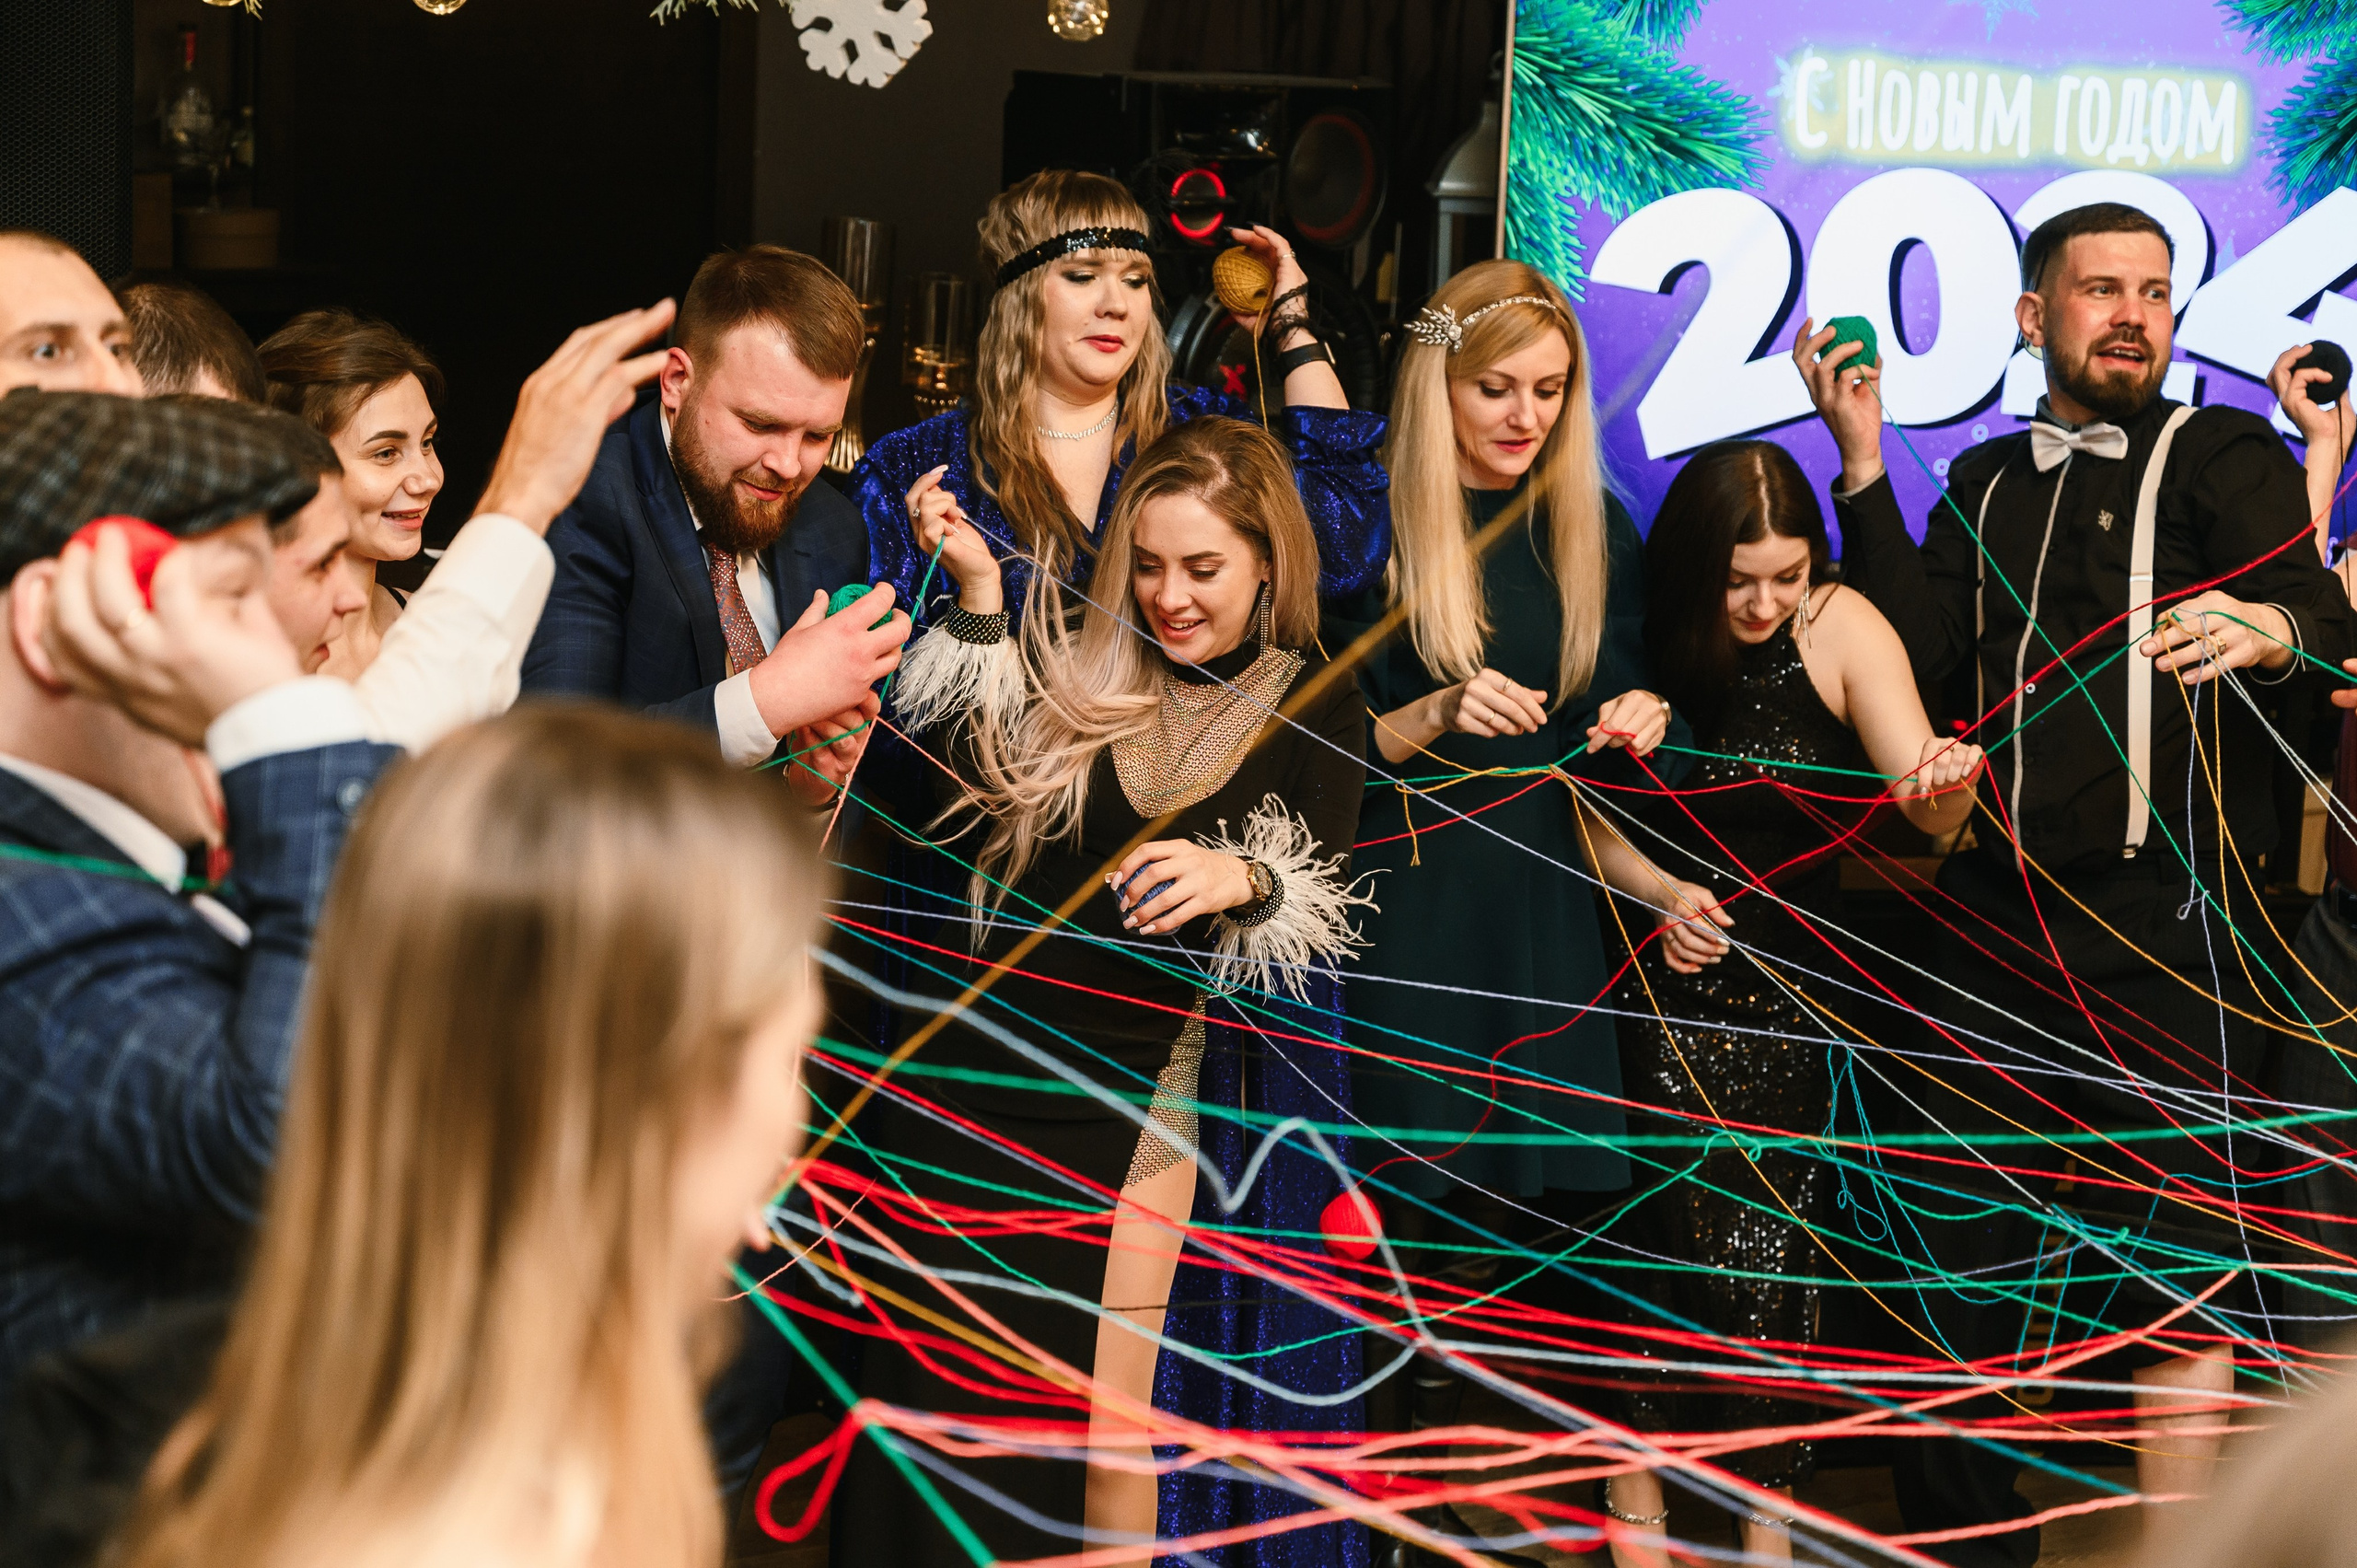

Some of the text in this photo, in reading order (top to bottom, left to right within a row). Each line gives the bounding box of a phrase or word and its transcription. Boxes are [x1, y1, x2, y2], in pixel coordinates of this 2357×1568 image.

[1794, 56, 2237, 166] С НОВЫМ ГОДОМ
